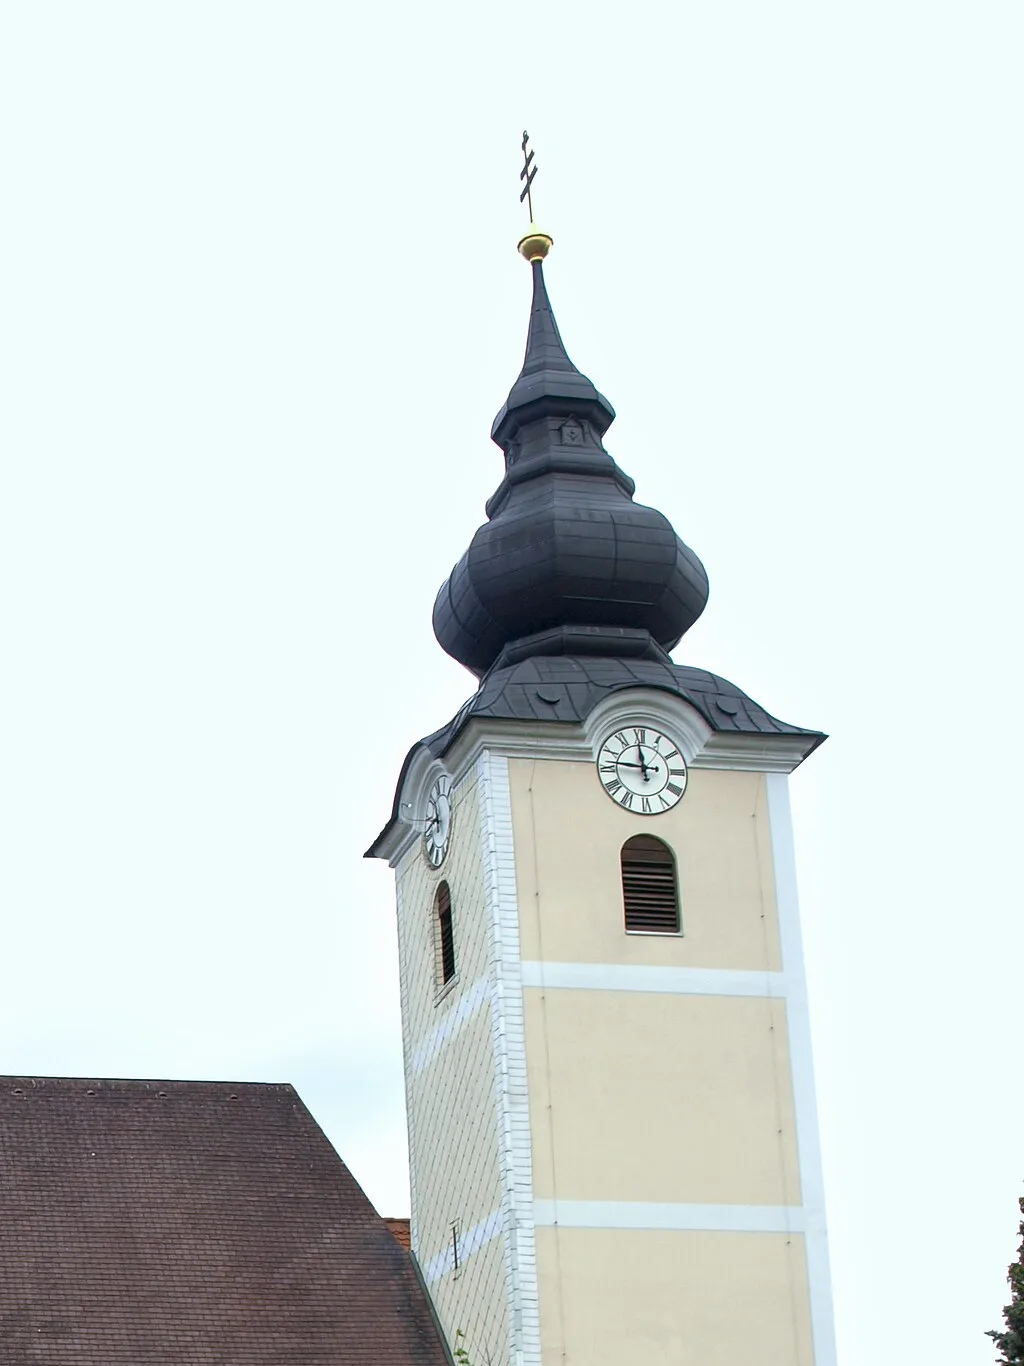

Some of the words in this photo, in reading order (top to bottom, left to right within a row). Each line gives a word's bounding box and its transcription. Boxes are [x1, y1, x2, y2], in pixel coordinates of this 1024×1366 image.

[615, 732, 630, 749] XI
[603, 745, 619, 759] X
[664, 750, 679, 760] II
[599, 764, 616, 773] IX
[641, 797, 652, 812] VI
[658, 794, 670, 810] V
